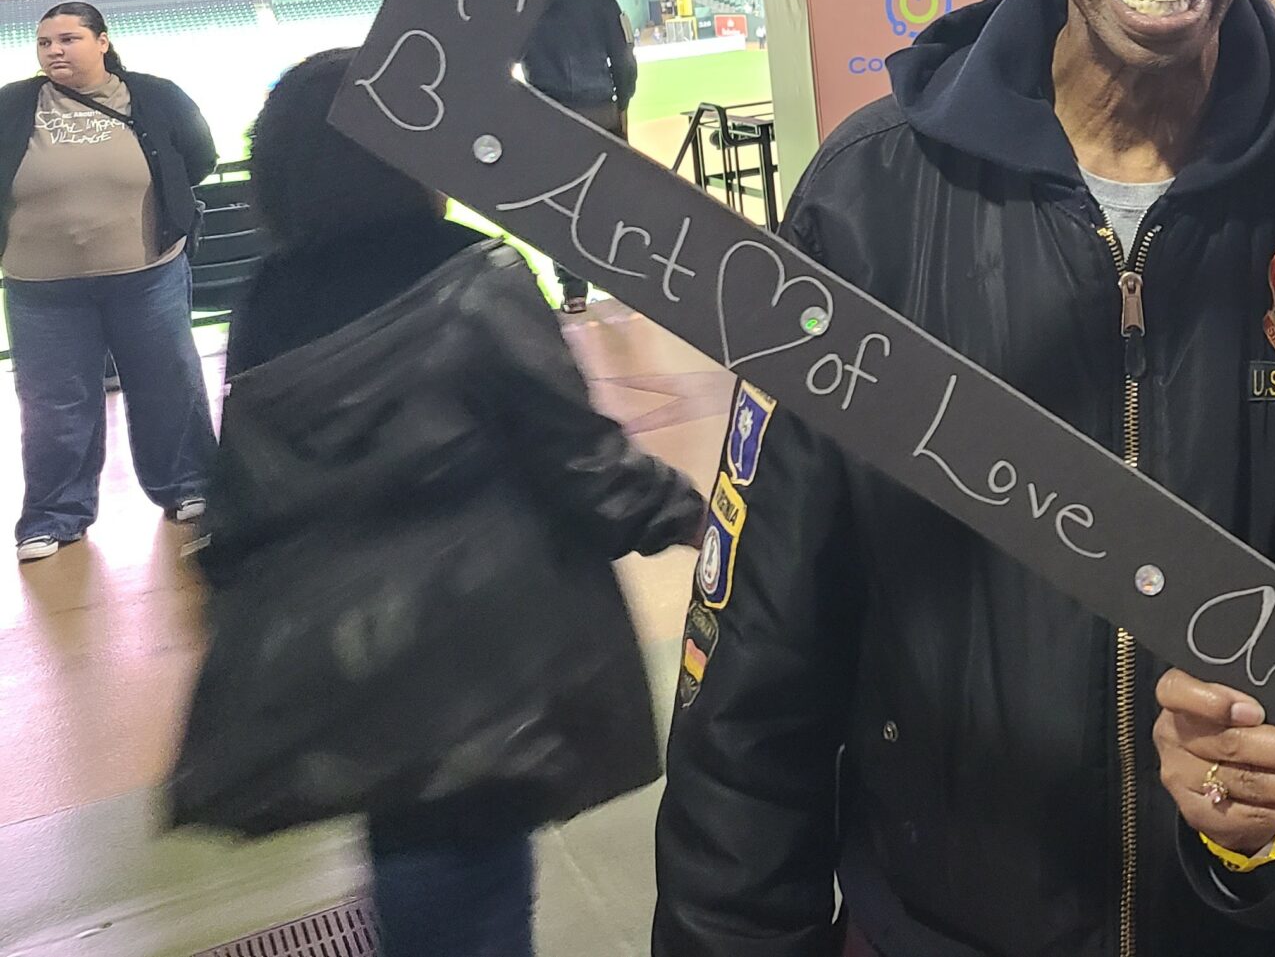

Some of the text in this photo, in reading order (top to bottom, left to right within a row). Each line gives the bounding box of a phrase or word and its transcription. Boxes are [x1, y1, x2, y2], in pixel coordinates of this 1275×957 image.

[496, 152, 1107, 558] Art of Love
